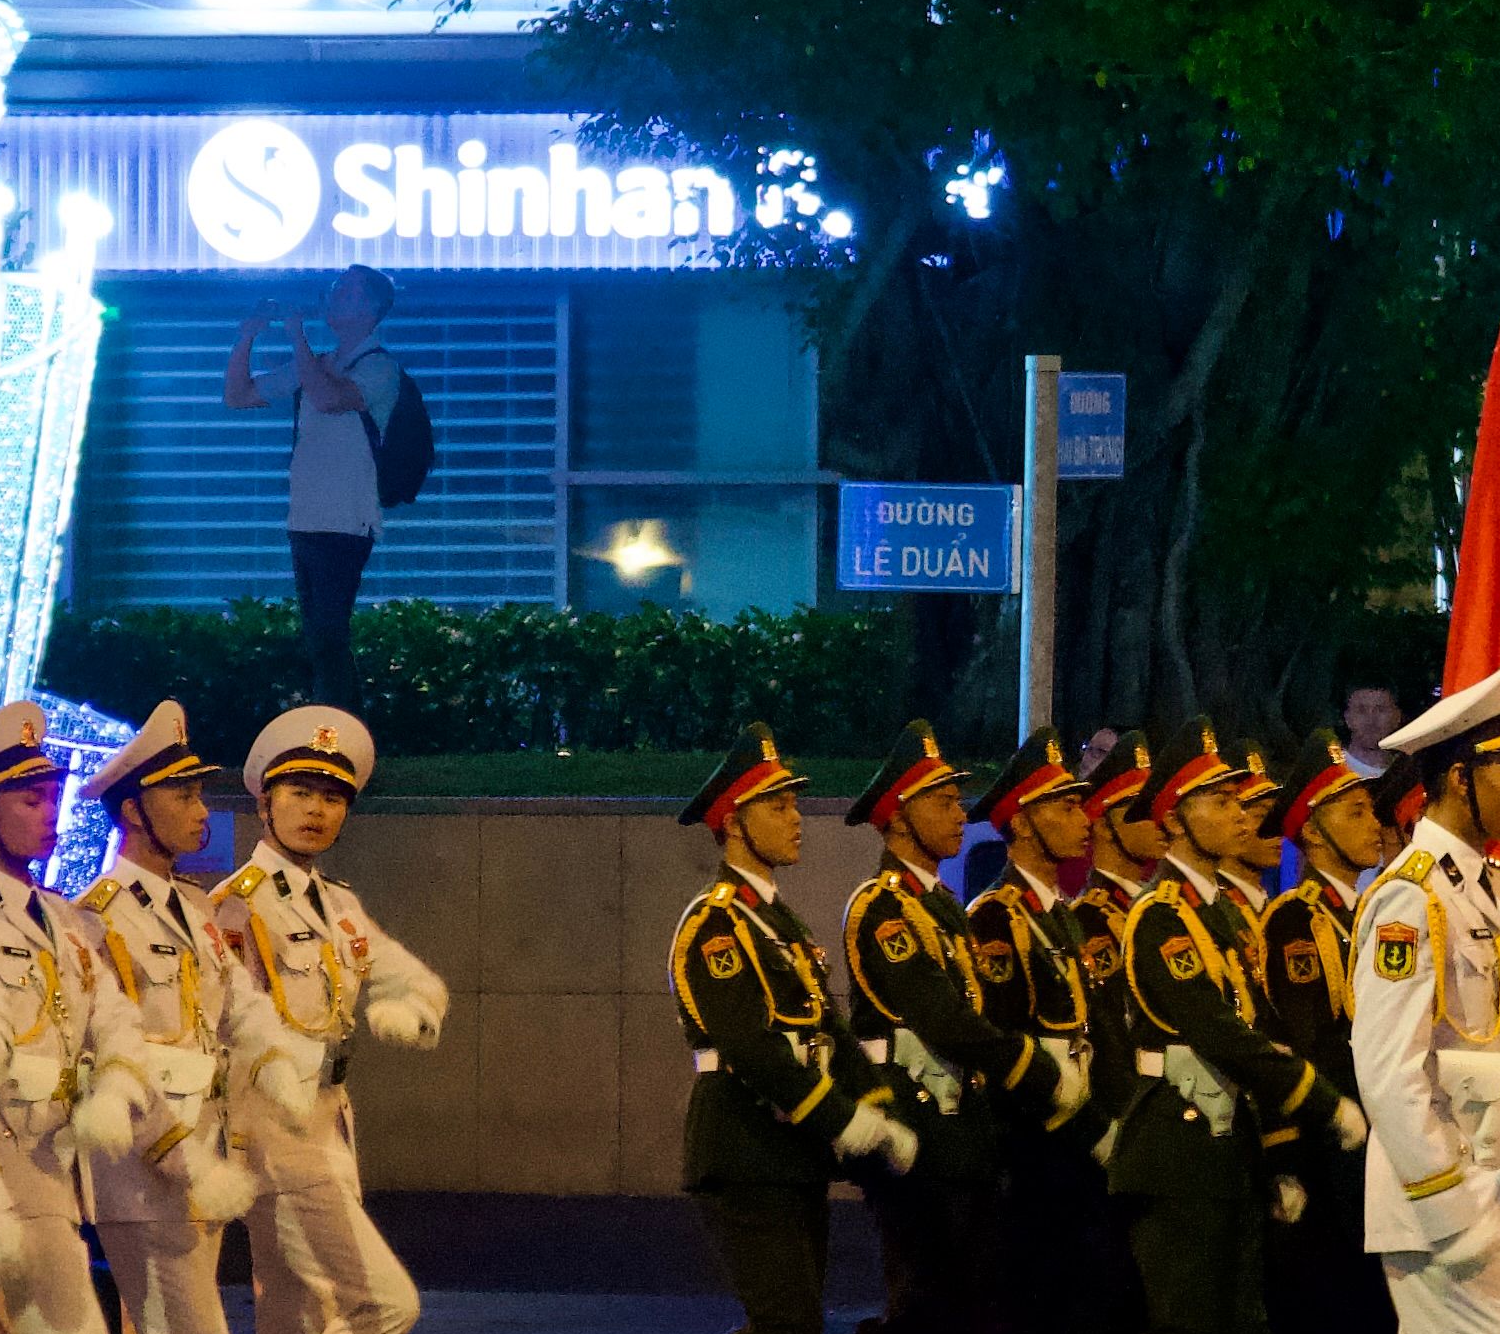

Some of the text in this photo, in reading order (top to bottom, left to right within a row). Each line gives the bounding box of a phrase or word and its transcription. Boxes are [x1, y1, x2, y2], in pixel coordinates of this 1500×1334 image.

[332, 140, 735, 240] Shinhan
[878, 496, 975, 527] ĐƯỜNG
[854, 532, 990, 578] LÊ DUẨN
